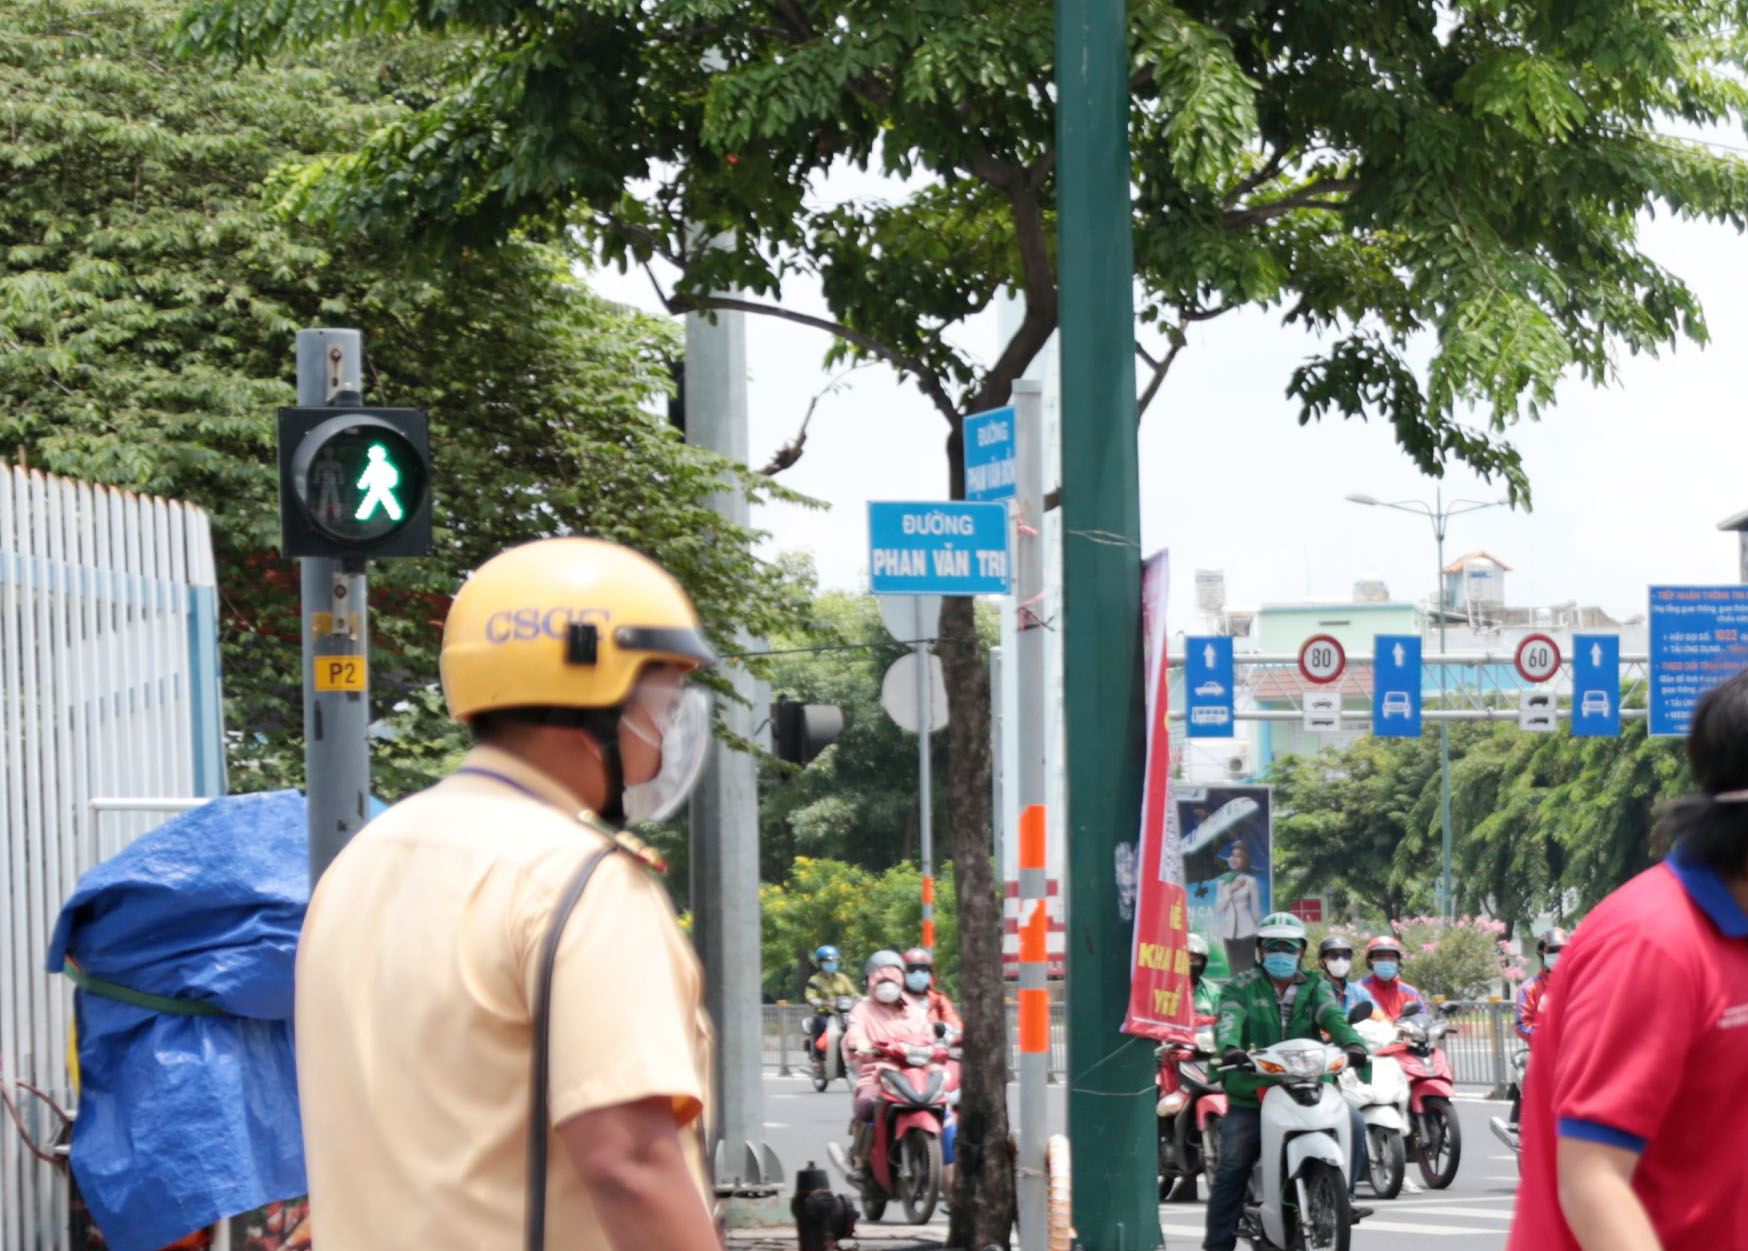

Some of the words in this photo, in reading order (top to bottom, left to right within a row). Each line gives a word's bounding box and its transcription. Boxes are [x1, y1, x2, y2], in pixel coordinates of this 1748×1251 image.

[902, 510, 974, 535] ĐƯỜNG
[872, 548, 928, 577] PHAN
[931, 543, 970, 577] VĂN
[975, 549, 1007, 585] TRỊ
[1715, 629, 1739, 641] 1022
[1312, 647, 1332, 668] 80
[1528, 647, 1548, 668] 60
[329, 662, 356, 684] P2
